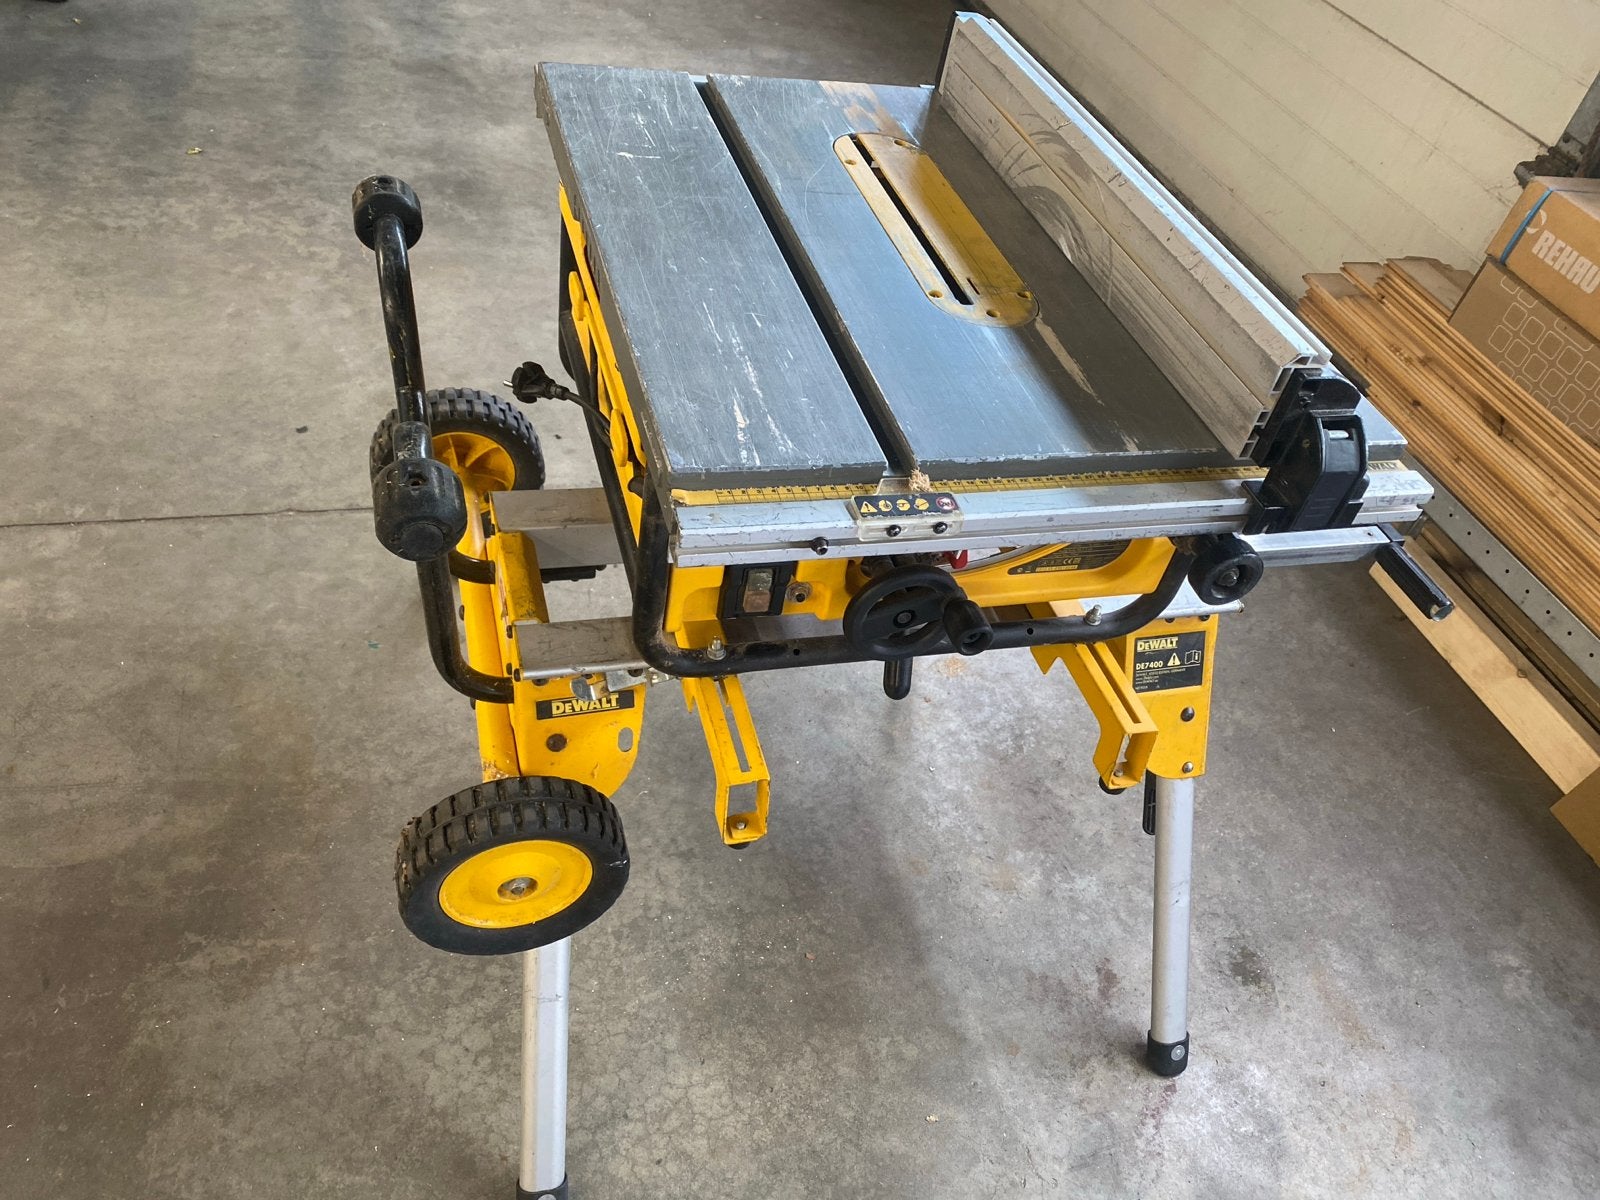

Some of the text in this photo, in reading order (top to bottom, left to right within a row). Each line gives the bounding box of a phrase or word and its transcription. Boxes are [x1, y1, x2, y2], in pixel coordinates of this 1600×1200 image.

[1531, 229, 1600, 294] REHAU
[1368, 461, 1398, 471] WALT
[1135, 661, 1164, 670] DE7400
